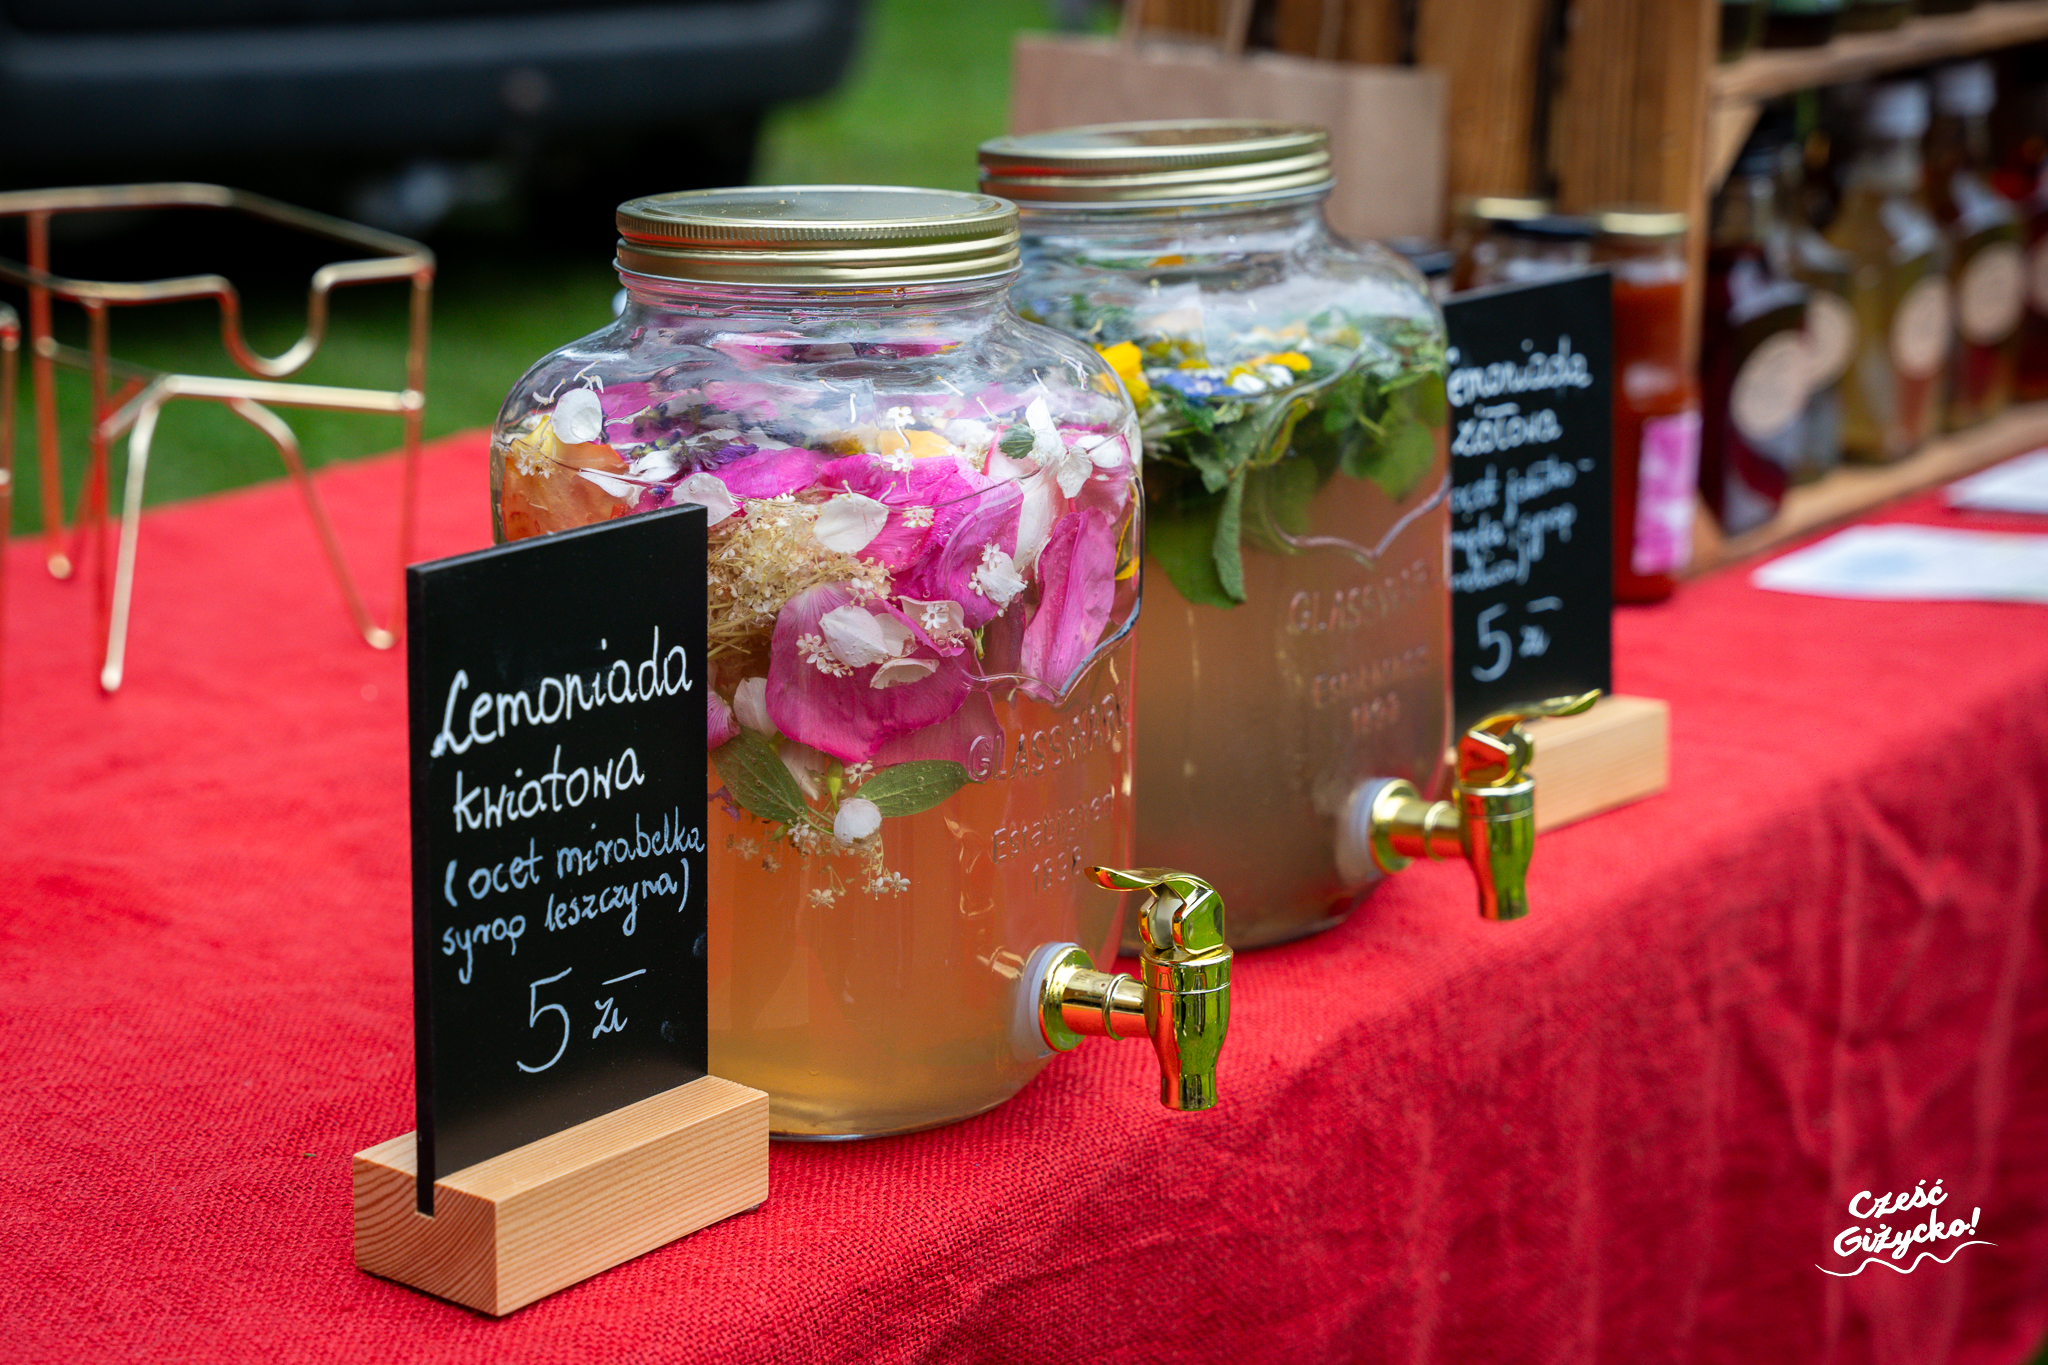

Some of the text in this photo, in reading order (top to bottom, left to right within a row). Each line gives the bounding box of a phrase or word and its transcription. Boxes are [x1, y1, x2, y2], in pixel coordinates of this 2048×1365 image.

[1444, 333, 1595, 408] emoniada
[1470, 601, 1513, 683] 5
[430, 625, 694, 759] Lemoniada
[452, 744, 646, 834] kwiatowa
[991, 784, 1117, 865] Established
[555, 805, 706, 881] mirabelka
[441, 914, 527, 986] syrop
[516, 966, 573, 1074] 5
